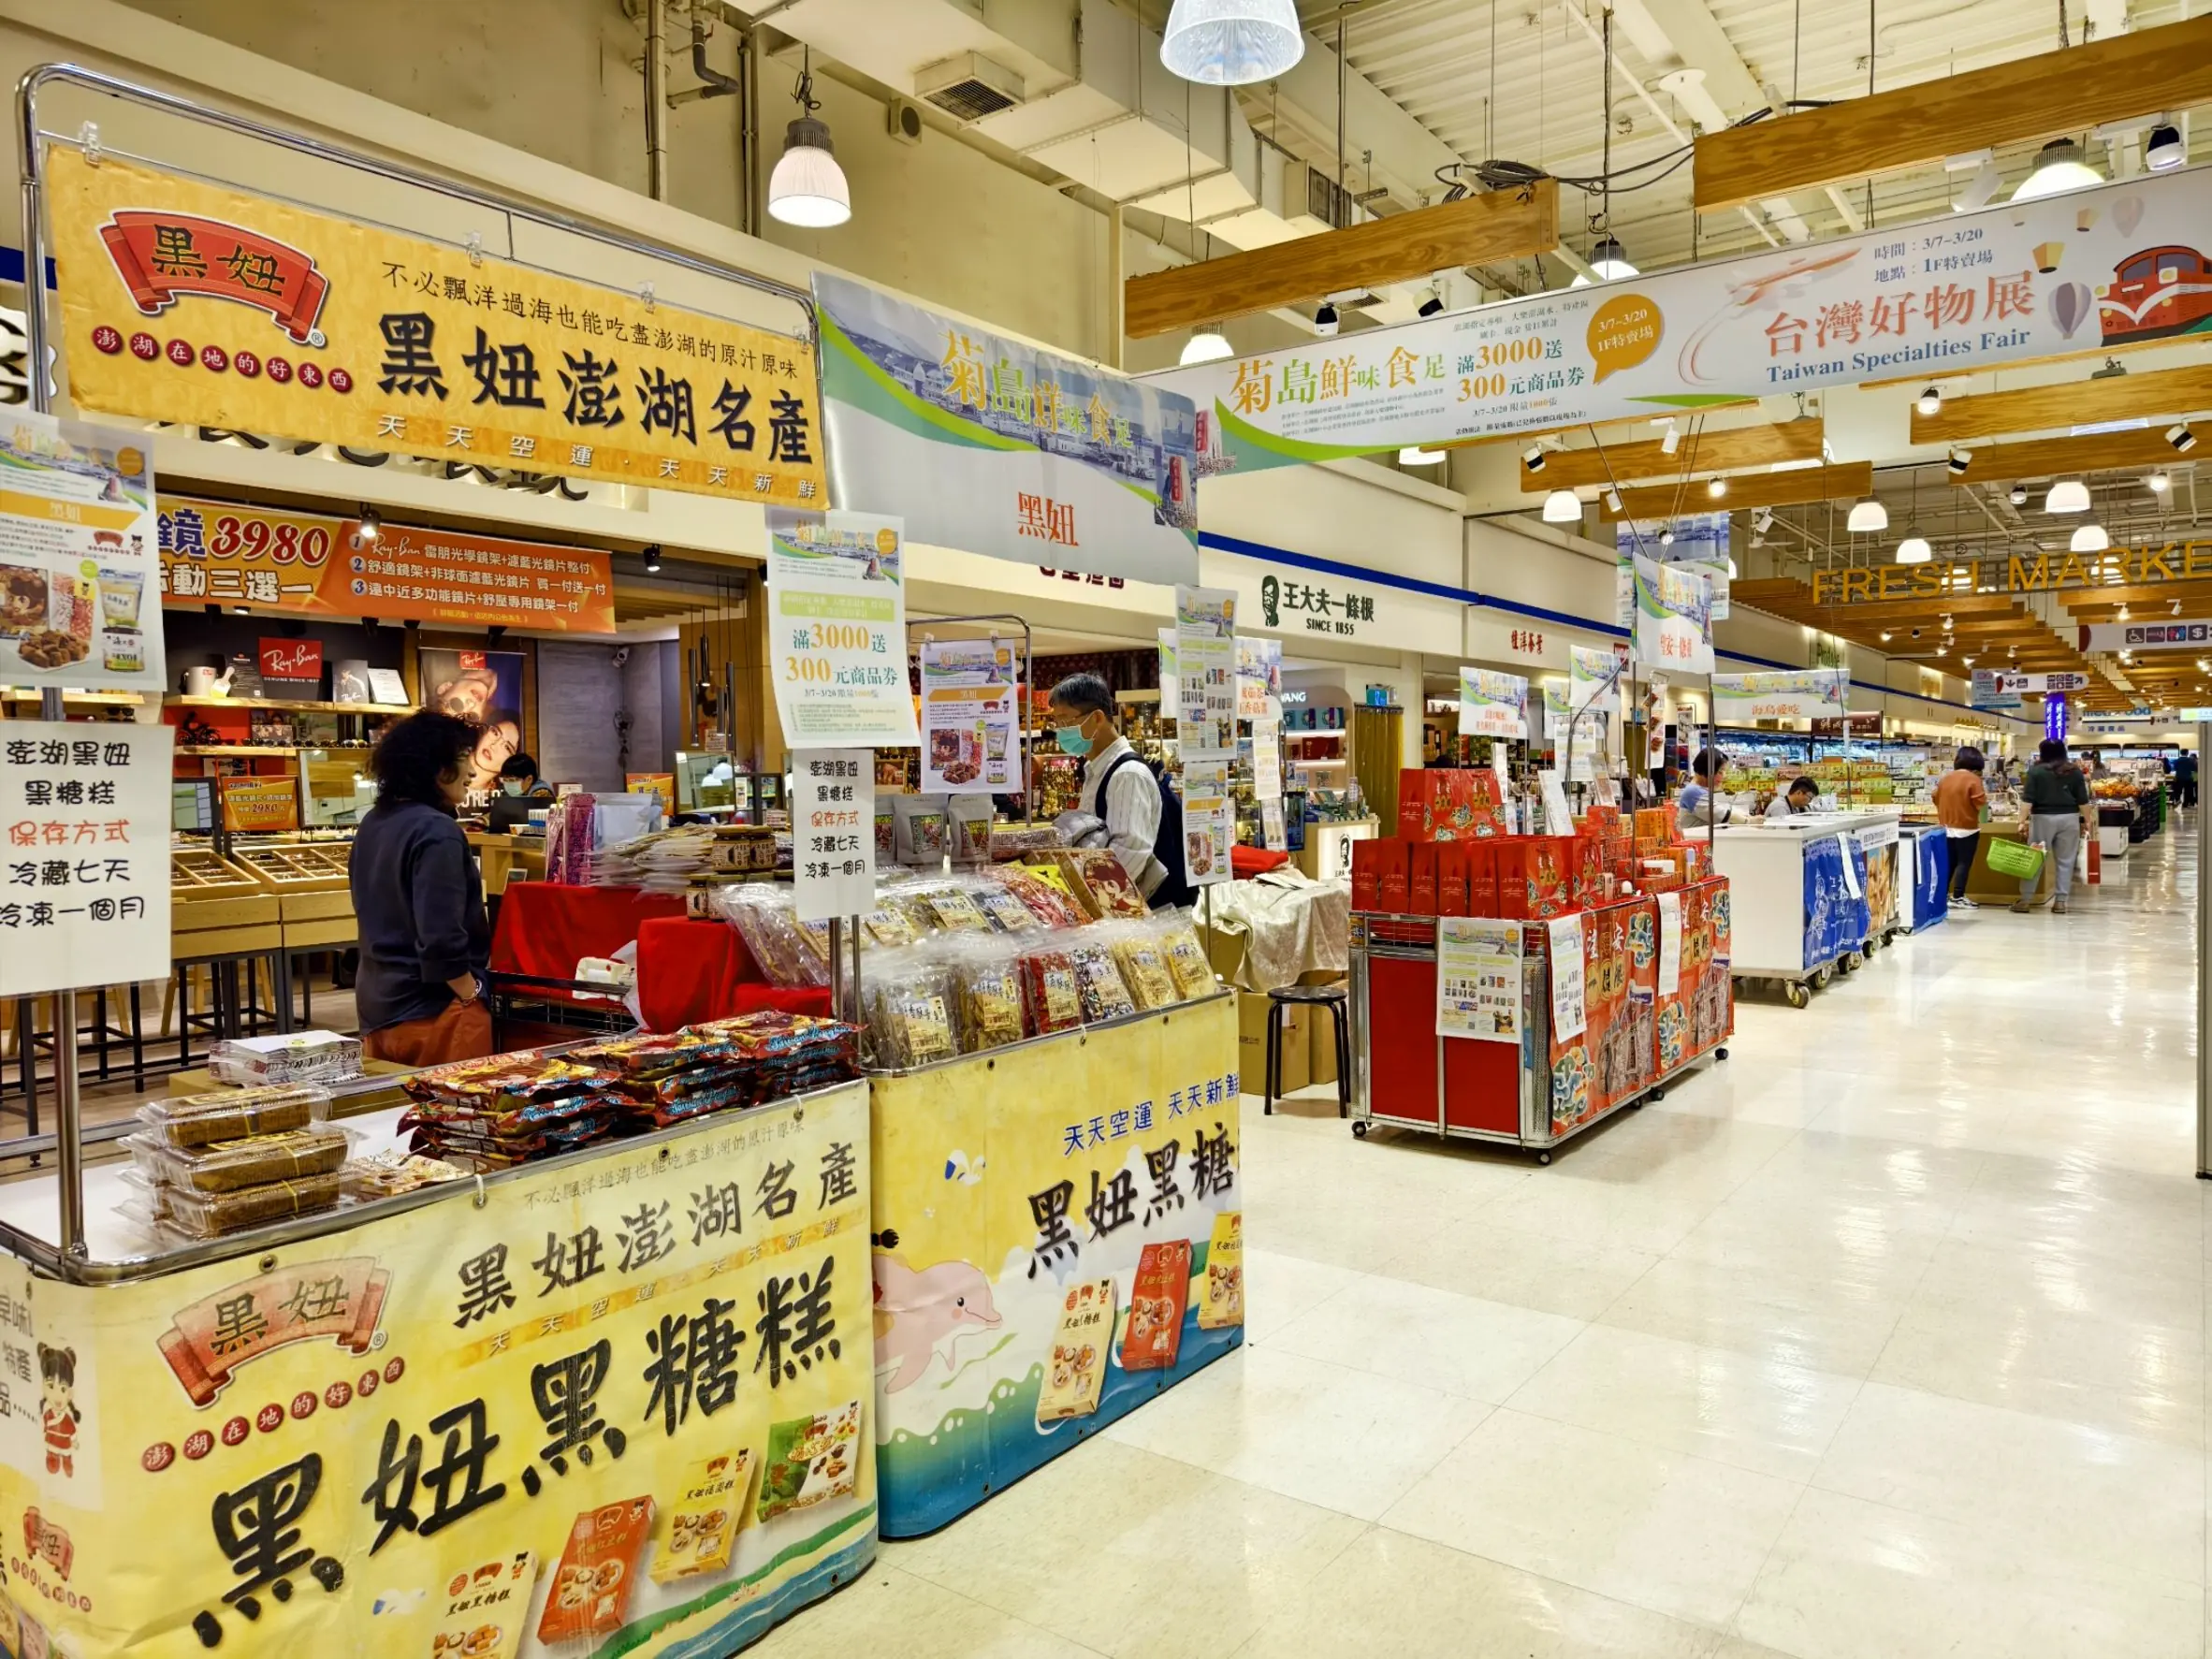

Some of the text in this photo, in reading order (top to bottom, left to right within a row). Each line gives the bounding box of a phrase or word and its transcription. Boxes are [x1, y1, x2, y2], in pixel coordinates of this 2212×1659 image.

[150, 224, 286, 296] 黑妞
[382, 261, 799, 379] 不必飄洋過海也能吃盡澎湖的原汁原味
[1765, 269, 2034, 358] 台灣好物展
[95, 327, 348, 390] 澎湖在地的好東西
[1767, 327, 2030, 384] Taiwan Specialties Fair
[377, 312, 812, 465] 黑妞澎湖名產
[1230, 346, 1447, 415] 菊島鮮味食足
[210, 517, 330, 566] 3980
[1017, 491, 1080, 547] 黑妞
[1283, 582, 1375, 622] 王大夫一條根
[1812, 560, 1979, 605] FRESH
[793, 623, 887, 653] 滿3000送
[1306, 618, 1355, 635] SINCE 1855
[785, 657, 898, 687] 300元商品券
[7, 739, 130, 766] 澎湖黑妞
[25, 779, 115, 806] 黑糖糕
[817, 785, 853, 802] 黑糖糕
[8, 820, 130, 847] 保存方式
[810, 811, 859, 827] 保存方式
[810, 835, 859, 852] 冷藏七天
[8, 859, 130, 886] 冷藏七天
[805, 859, 866, 879] 冷凍一個月
[0, 896, 145, 928] 冷凍一個月
[1063, 1071, 1240, 1157] 天天空運 天天新鮮
[1026, 1122, 1240, 1280] 黑妞黑糖
[454, 1141, 858, 1330] 黑妞澎湖名產
[210, 1274, 350, 1358] 黑妞
[145, 1359, 402, 1468] 澎湖在地的好東西
[193, 1256, 841, 1648] 黑妞黑糖糕
